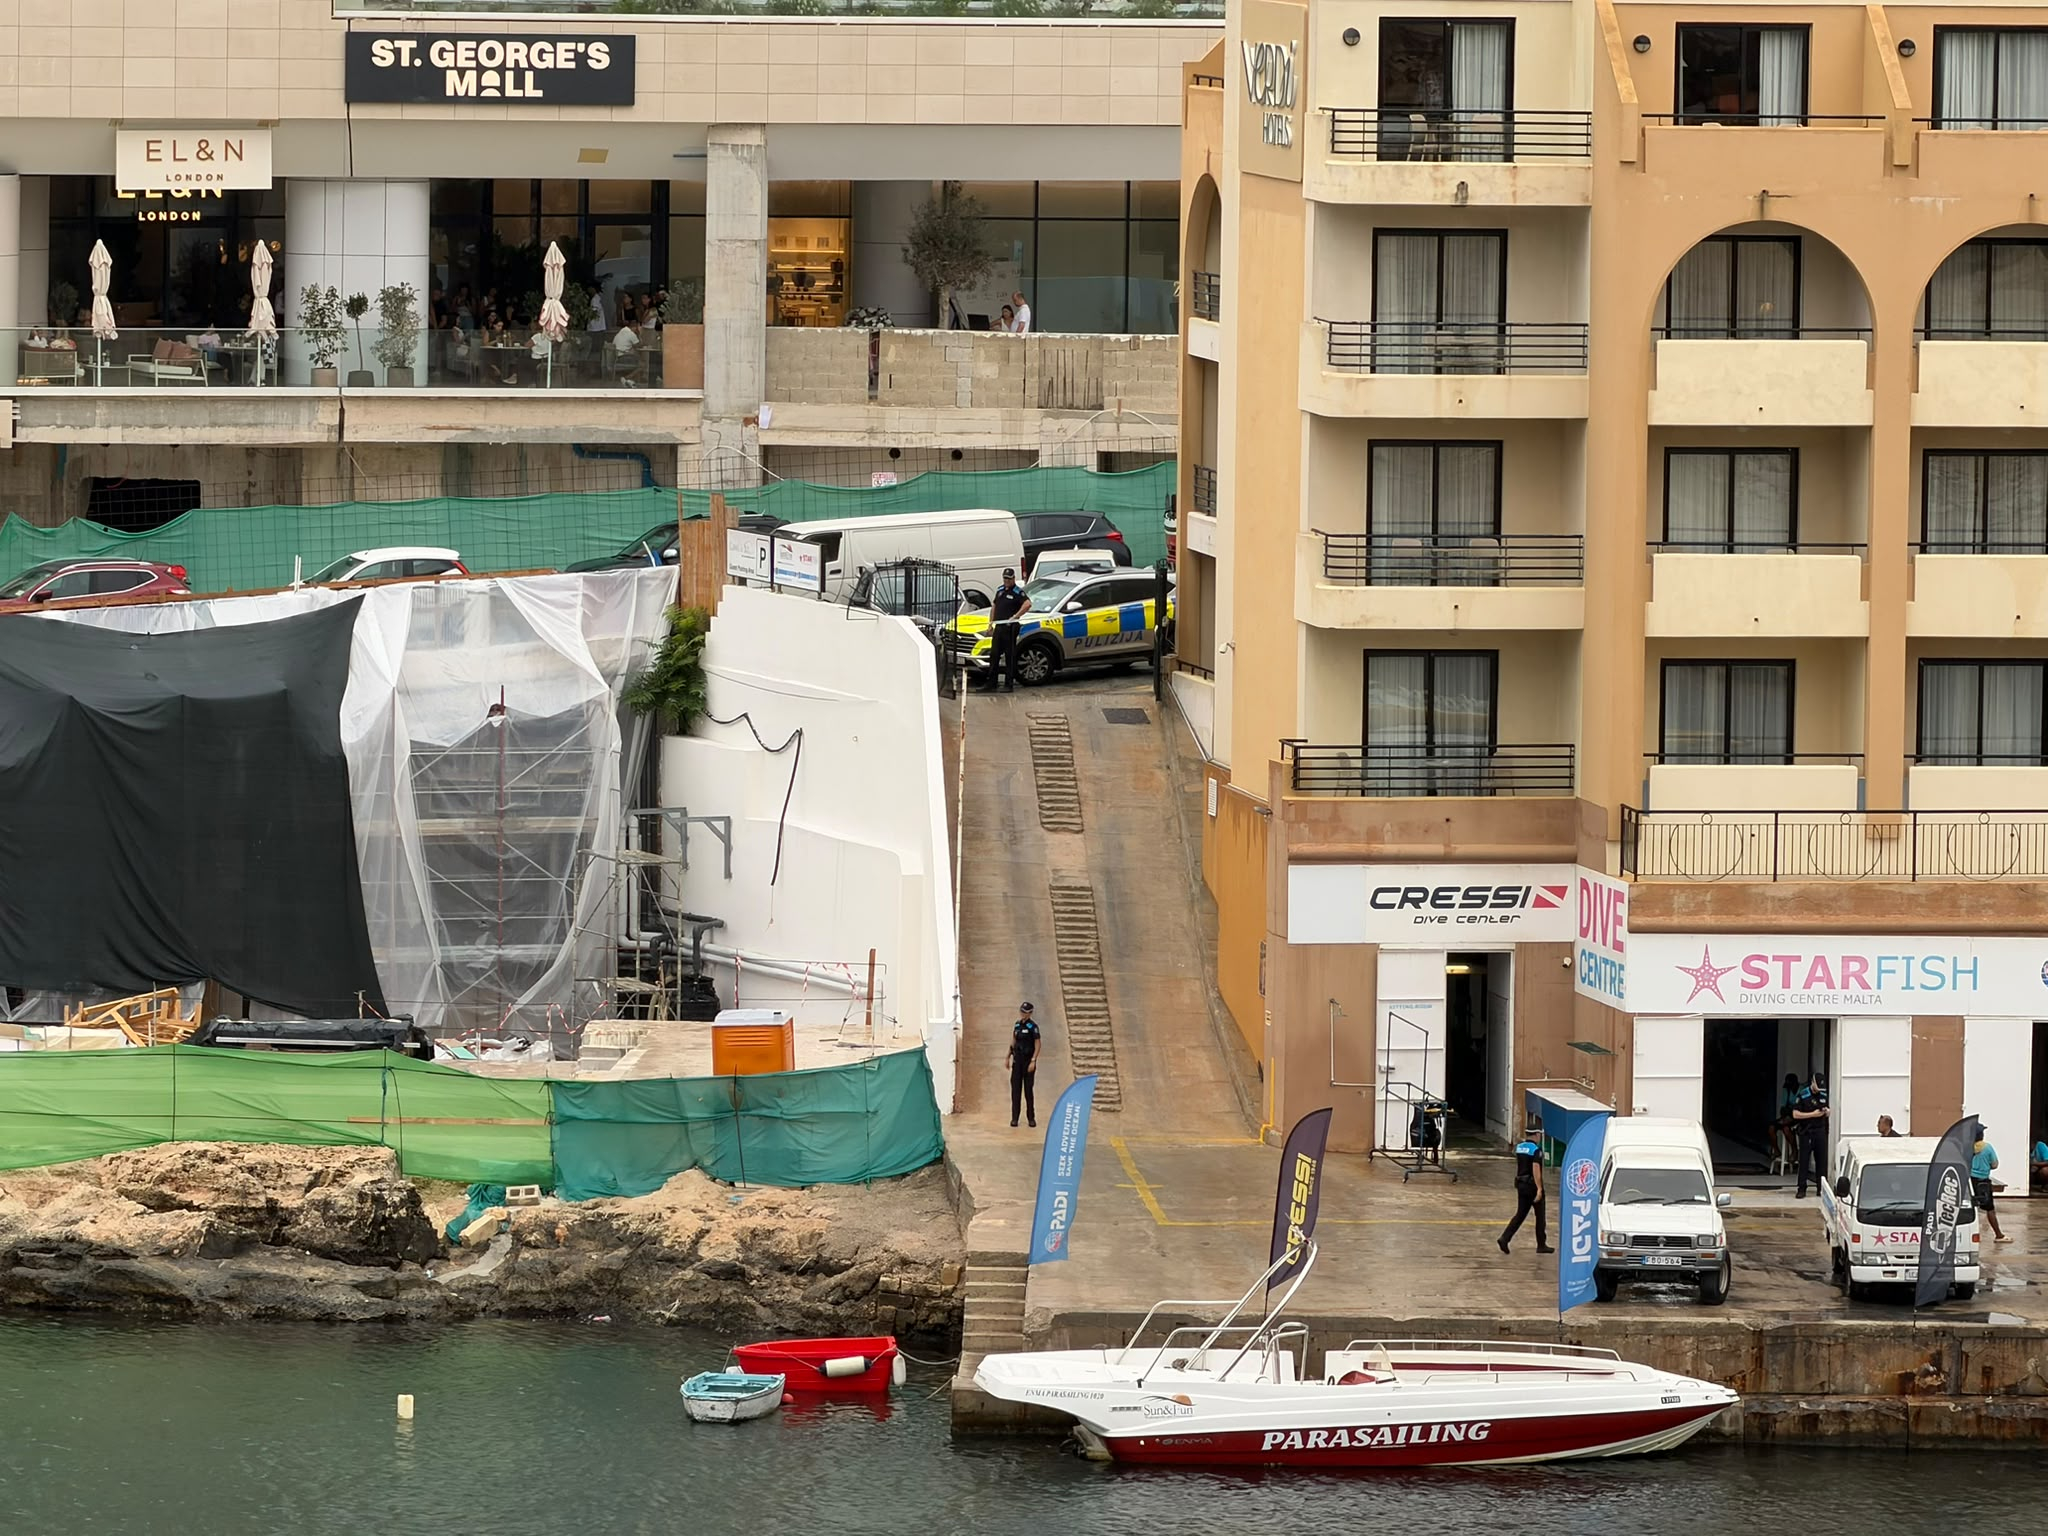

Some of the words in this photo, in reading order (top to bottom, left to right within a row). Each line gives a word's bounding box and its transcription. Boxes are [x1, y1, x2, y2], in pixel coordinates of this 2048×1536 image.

[371, 39, 423, 68] ST.
[429, 39, 611, 70] GEORGE'S
[445, 69, 543, 97] MALL
[145, 138, 244, 162] EL&N
[166, 173, 225, 182] LONDON
[138, 210, 201, 221] LONDON
[1073, 630, 1145, 650] PULIZIJA
[1369, 885, 1533, 910] CRESSI
[1579, 876, 1626, 954] DIVE
[1579, 948, 1625, 1000] CENTRE
[1739, 953, 1979, 991] STARFISH
[1739, 992, 1786, 1005] DIVING
[1789, 993, 1840, 1005] CENTRE
[1843, 993, 1883, 1006] MALTA
[1069, 1134, 1078, 1153] THE
[1058, 1153, 1067, 1177] SEEK
[1065, 1156, 1074, 1177] SAVE
[1050, 1190, 1069, 1231] PADI
[1571, 1199, 1592, 1264] PADI
[1925, 1211, 1935, 1236] PADI
[1889, 1231, 1919, 1243] STA
[1261, 1422, 1492, 1451] PARASAILING
